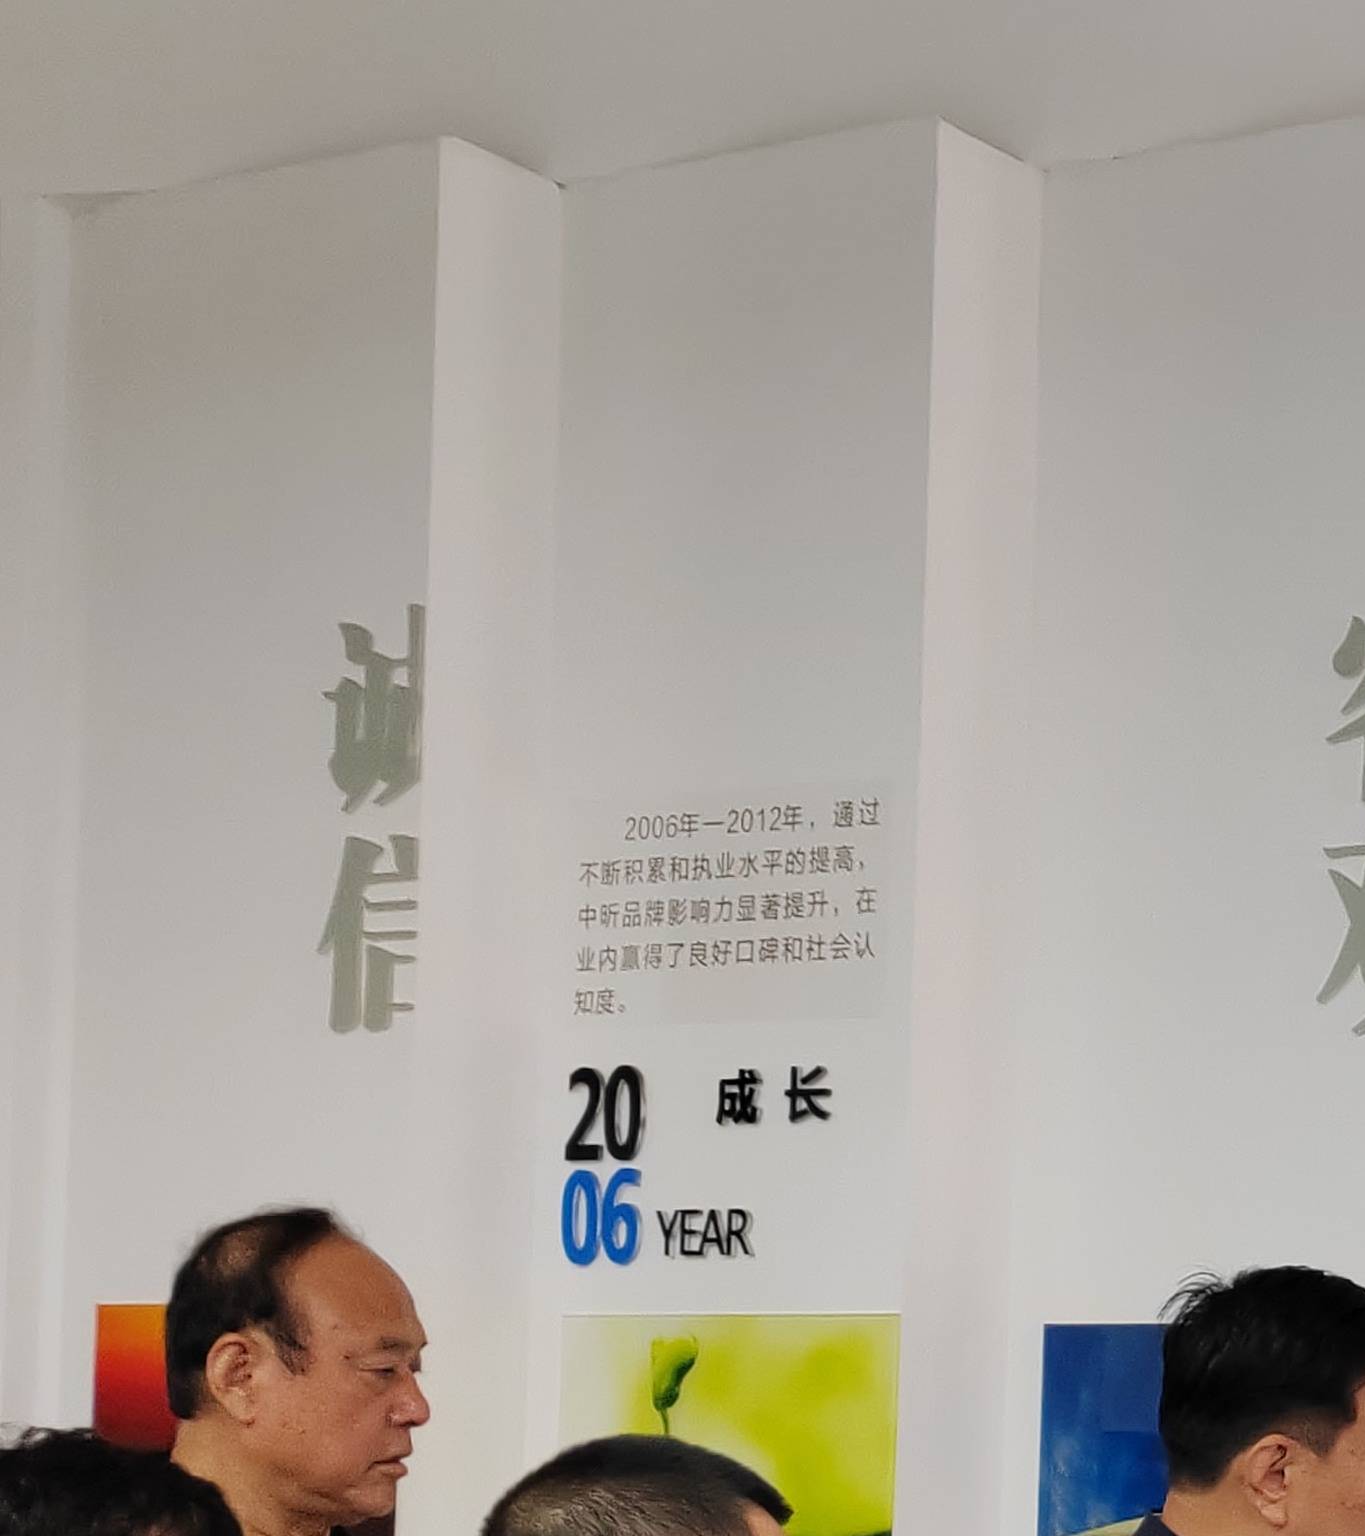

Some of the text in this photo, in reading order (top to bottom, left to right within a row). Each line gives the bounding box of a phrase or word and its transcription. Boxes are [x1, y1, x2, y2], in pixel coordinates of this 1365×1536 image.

[565, 1064, 645, 1162] 20
[560, 1167, 755, 1266] 06 YEAR
